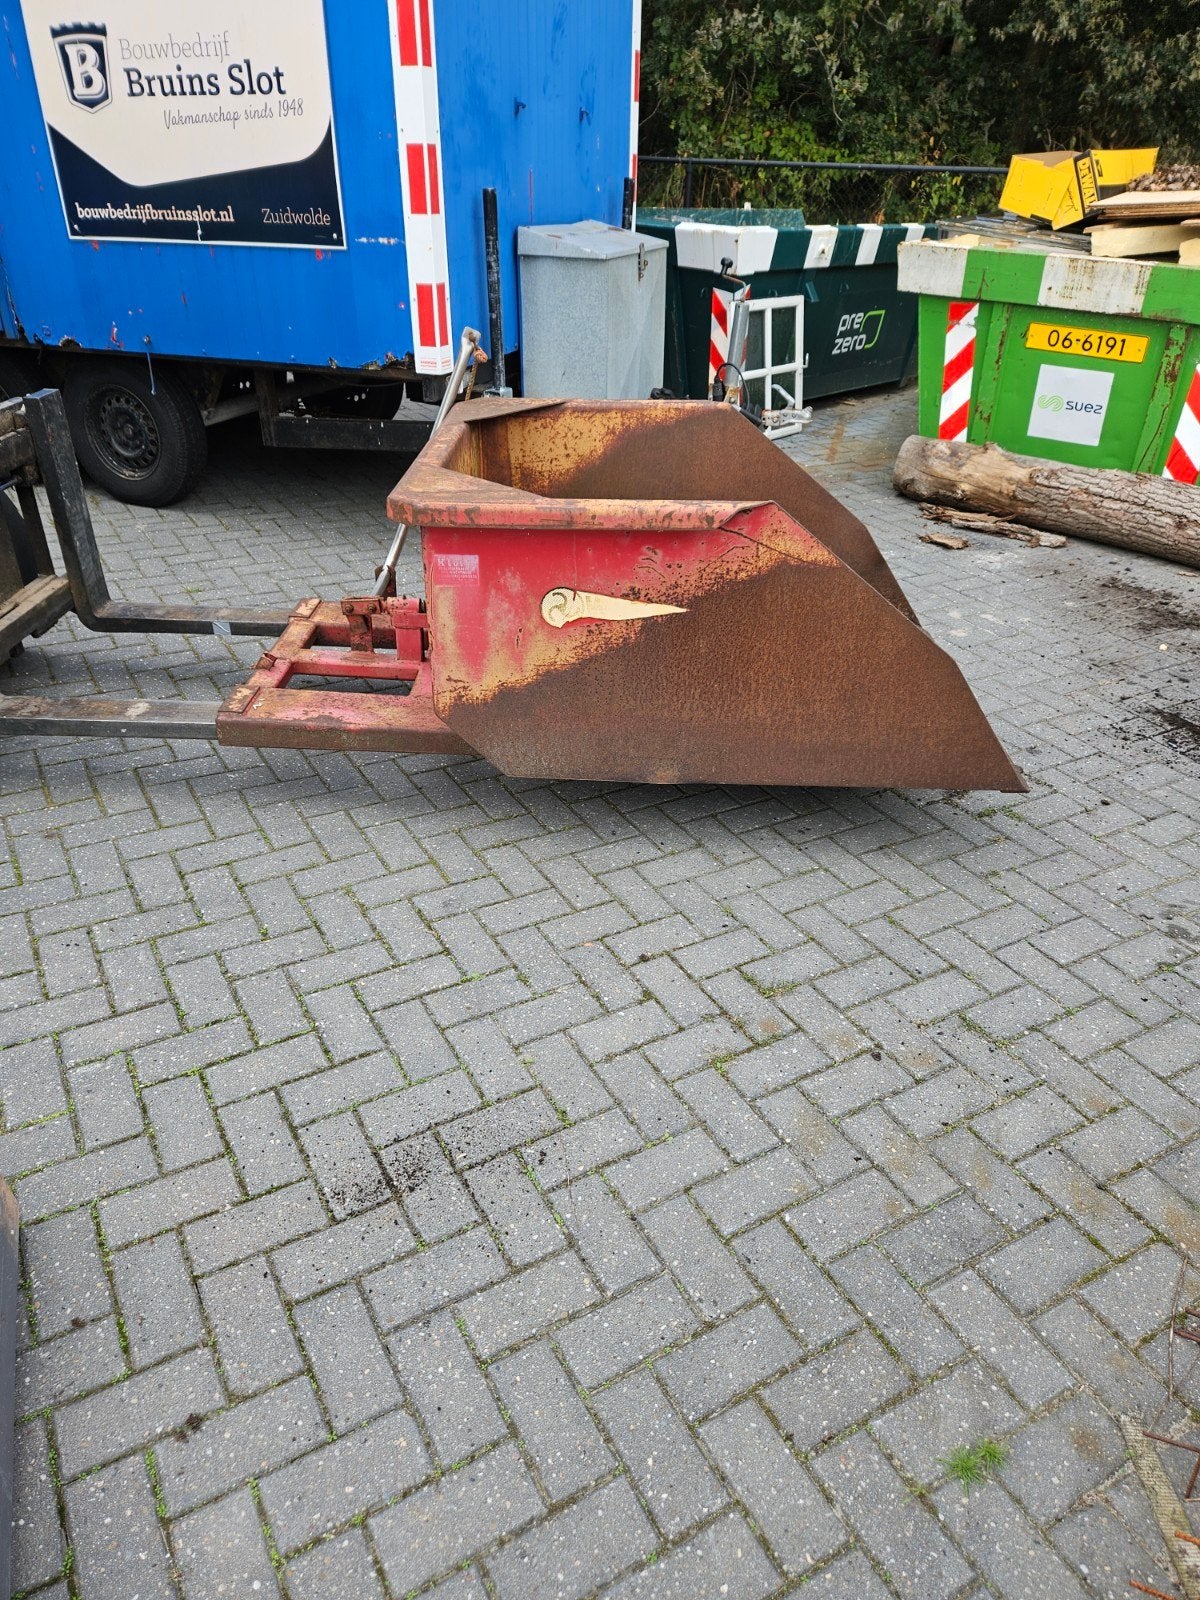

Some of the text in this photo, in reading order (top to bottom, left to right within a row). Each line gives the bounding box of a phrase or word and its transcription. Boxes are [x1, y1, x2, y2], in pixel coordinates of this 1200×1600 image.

[118, 30, 231, 63] Bouwbedrijf
[64, 43, 106, 98] B
[123, 58, 287, 97] Bruins Slot
[164, 98, 304, 130] Vakmanschap sinds 1948
[1077, 156, 1098, 211] DEWAL
[75, 202, 235, 224] bouwbedrijfbruinsslot.nl
[261, 206, 331, 226] Zuidwolde
[836, 312, 864, 337] pre
[831, 334, 867, 355] zero
[1047, 329, 1127, 356] 06-6191
[1065, 400, 1103, 415] suez
